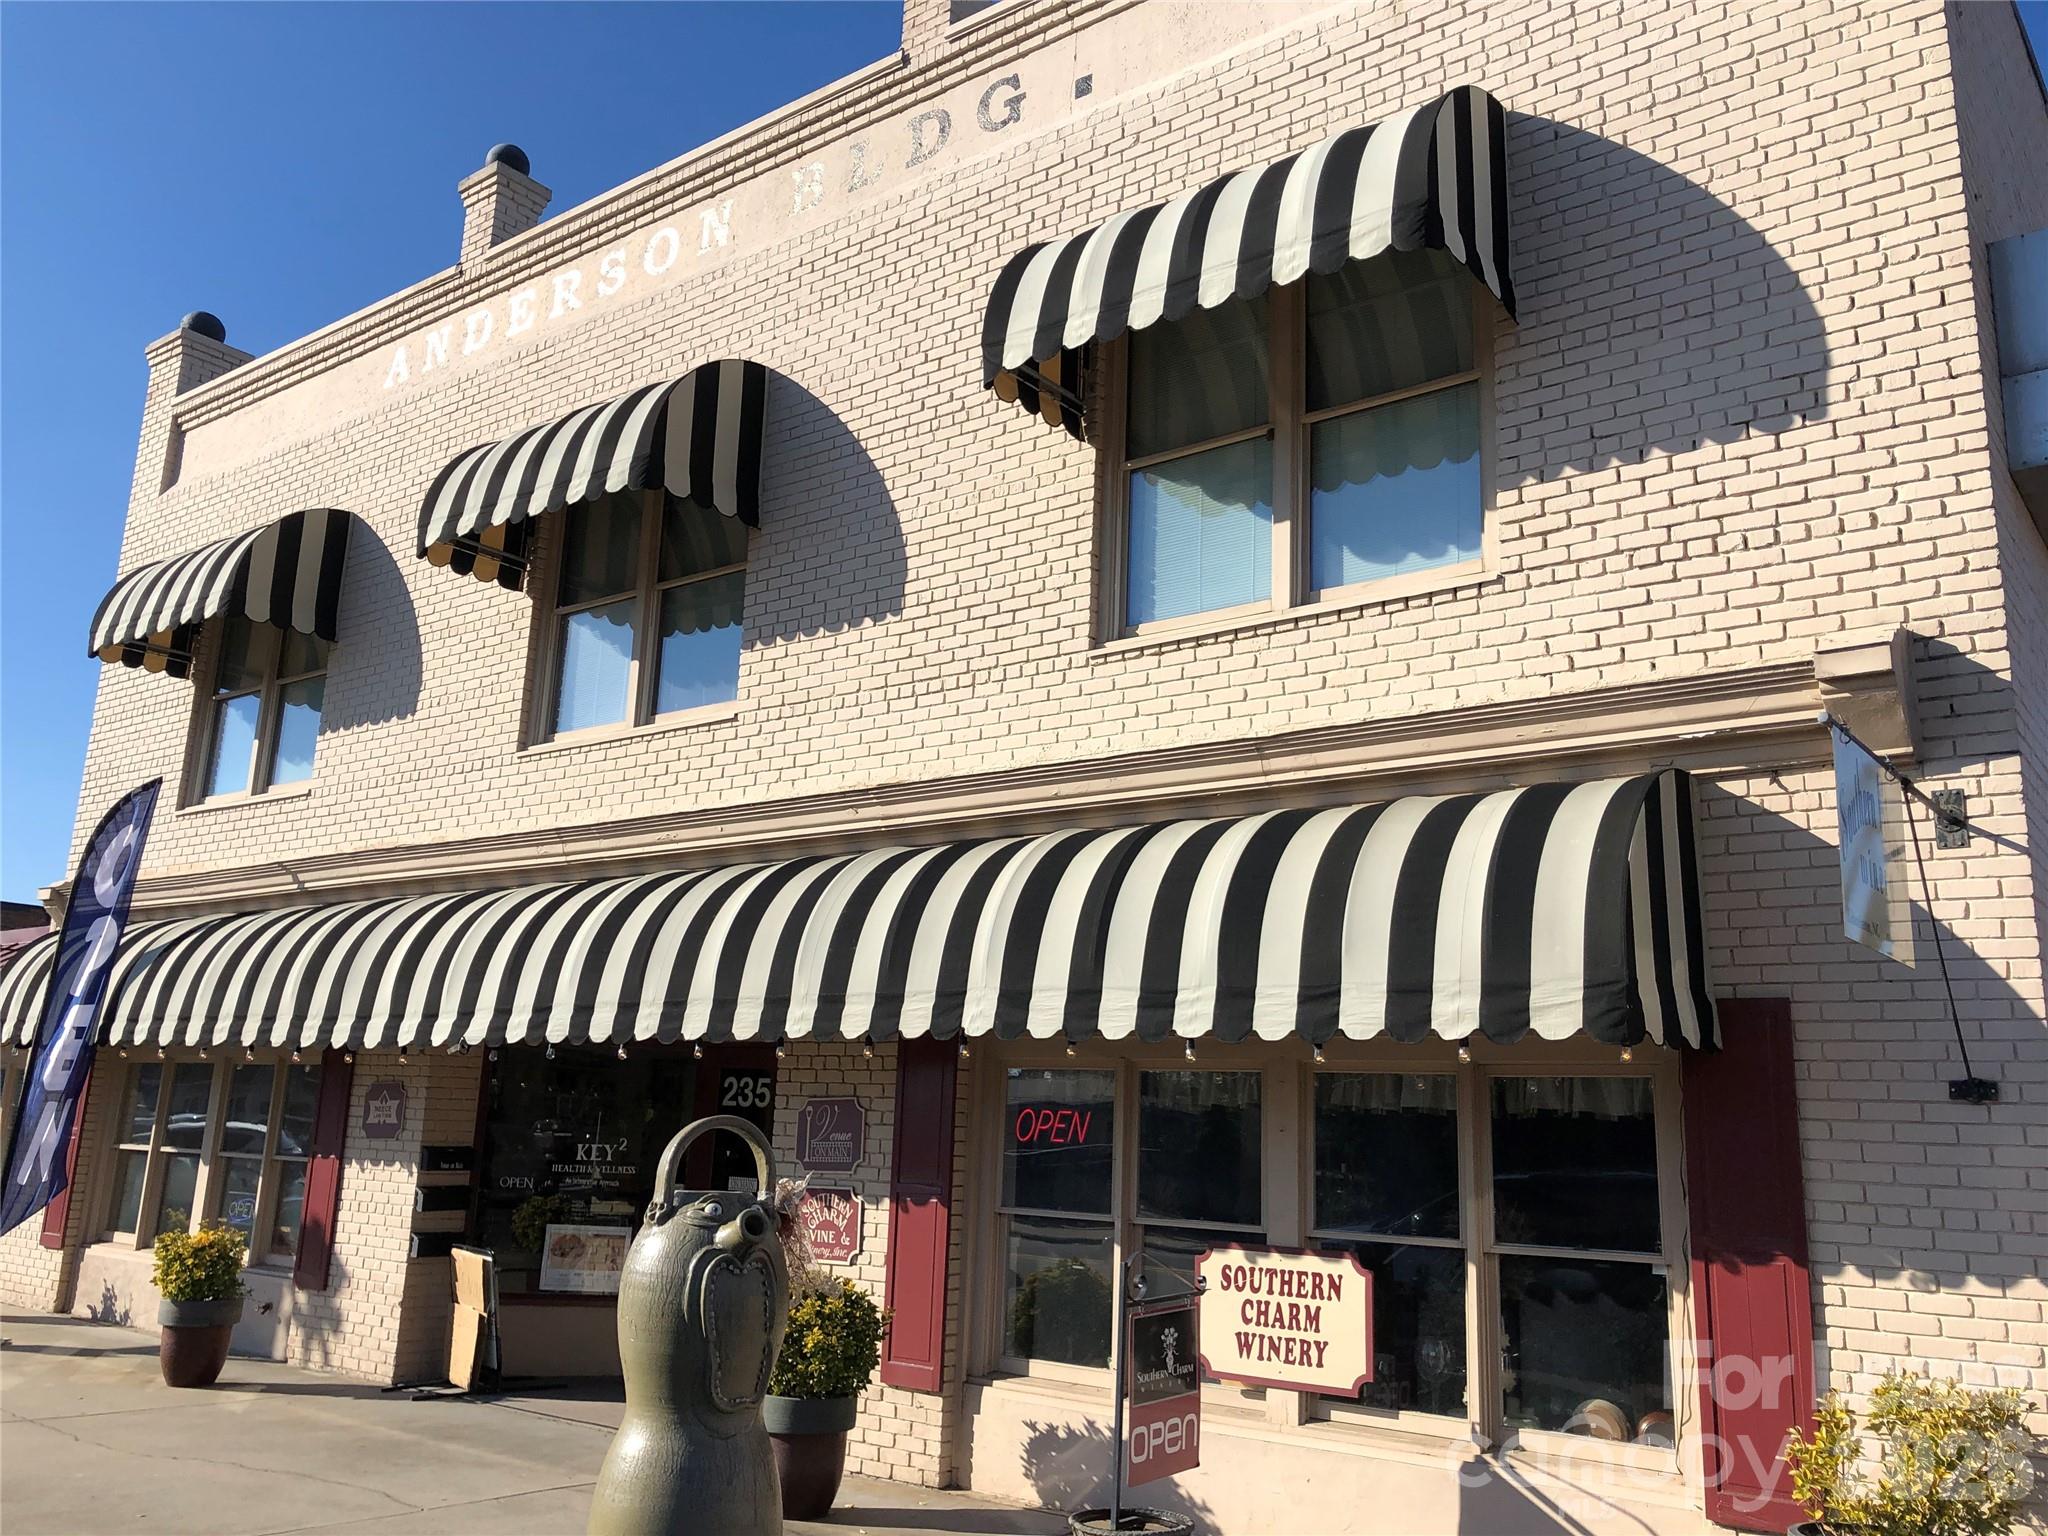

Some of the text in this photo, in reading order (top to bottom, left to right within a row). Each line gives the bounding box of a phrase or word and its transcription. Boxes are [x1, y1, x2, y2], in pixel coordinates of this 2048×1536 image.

[383, 199, 734, 389] ANDERSON
[17, 822, 141, 1185] OPEN
[722, 1076, 771, 1108] 235
[814, 1105, 852, 1141] Venue
[1016, 1109, 1091, 1143] OPEN
[815, 1146, 848, 1157] ON MAIN
[499, 1175, 534, 1189] OPEN
[552, 1163, 586, 1174] HEALTH
[802, 1192, 853, 1219] SOUTHERN
[808, 1207, 848, 1232] CHARM
[841, 1232, 850, 1245] &
[1221, 1264, 1343, 1302] SOUTHERN
[1241, 1298, 1321, 1333] CHARM
[1235, 1332, 1328, 1368] WINERY
